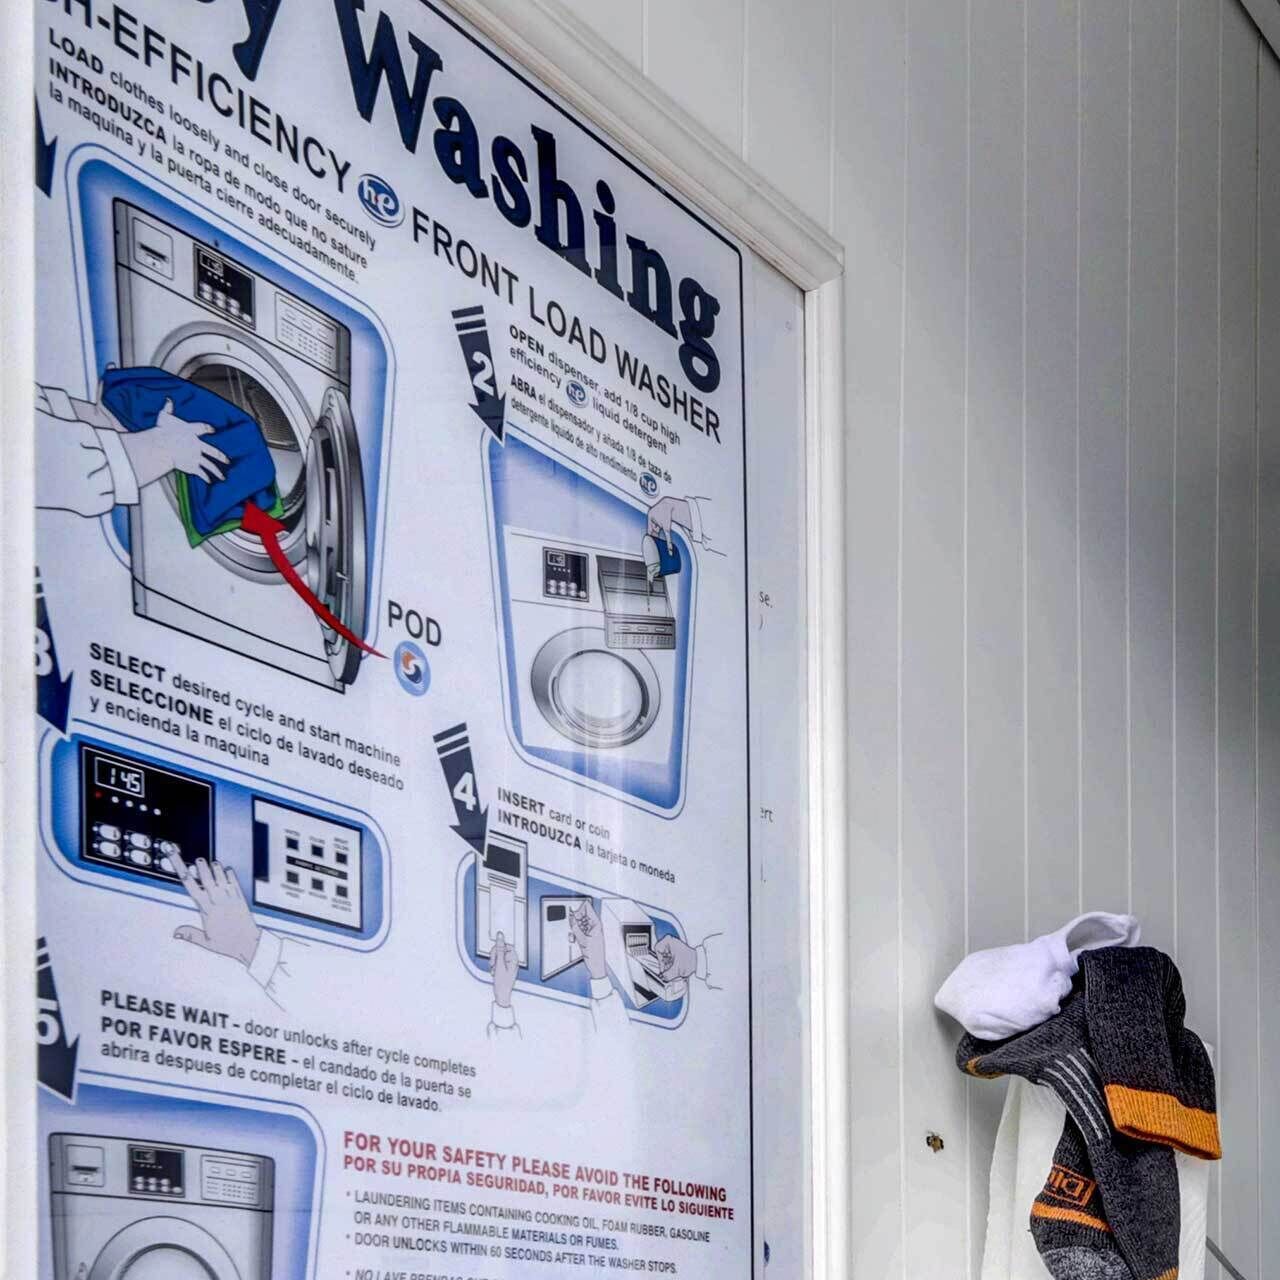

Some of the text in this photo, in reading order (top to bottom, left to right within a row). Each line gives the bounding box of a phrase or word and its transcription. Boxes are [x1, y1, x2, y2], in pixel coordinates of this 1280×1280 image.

[48, 27, 375, 251] LOAD clothes loosely and close door securely
[335, 0, 720, 394] Washing
[412, 206, 518, 305] FRONT
[529, 285, 606, 364] LOAD
[614, 343, 720, 444] WASHER
[388, 599, 441, 646] POD
[89, 642, 400, 766] SELECT desired cycle and start machine
[497, 787, 609, 838] INSERT card or coin
[100, 989, 176, 1019] PLEASE
[181, 1005, 228, 1028] WAIT
[244, 1019, 279, 1038] door
[283, 1029, 338, 1050] unlocks
[342, 1039, 372, 1056] after
[376, 1048, 409, 1064] cycle
[413, 1055, 475, 1077] completes
[344, 1130, 726, 1202] FOR YOUR SAFETY PLEASE AVOID THE FOLLOWING
